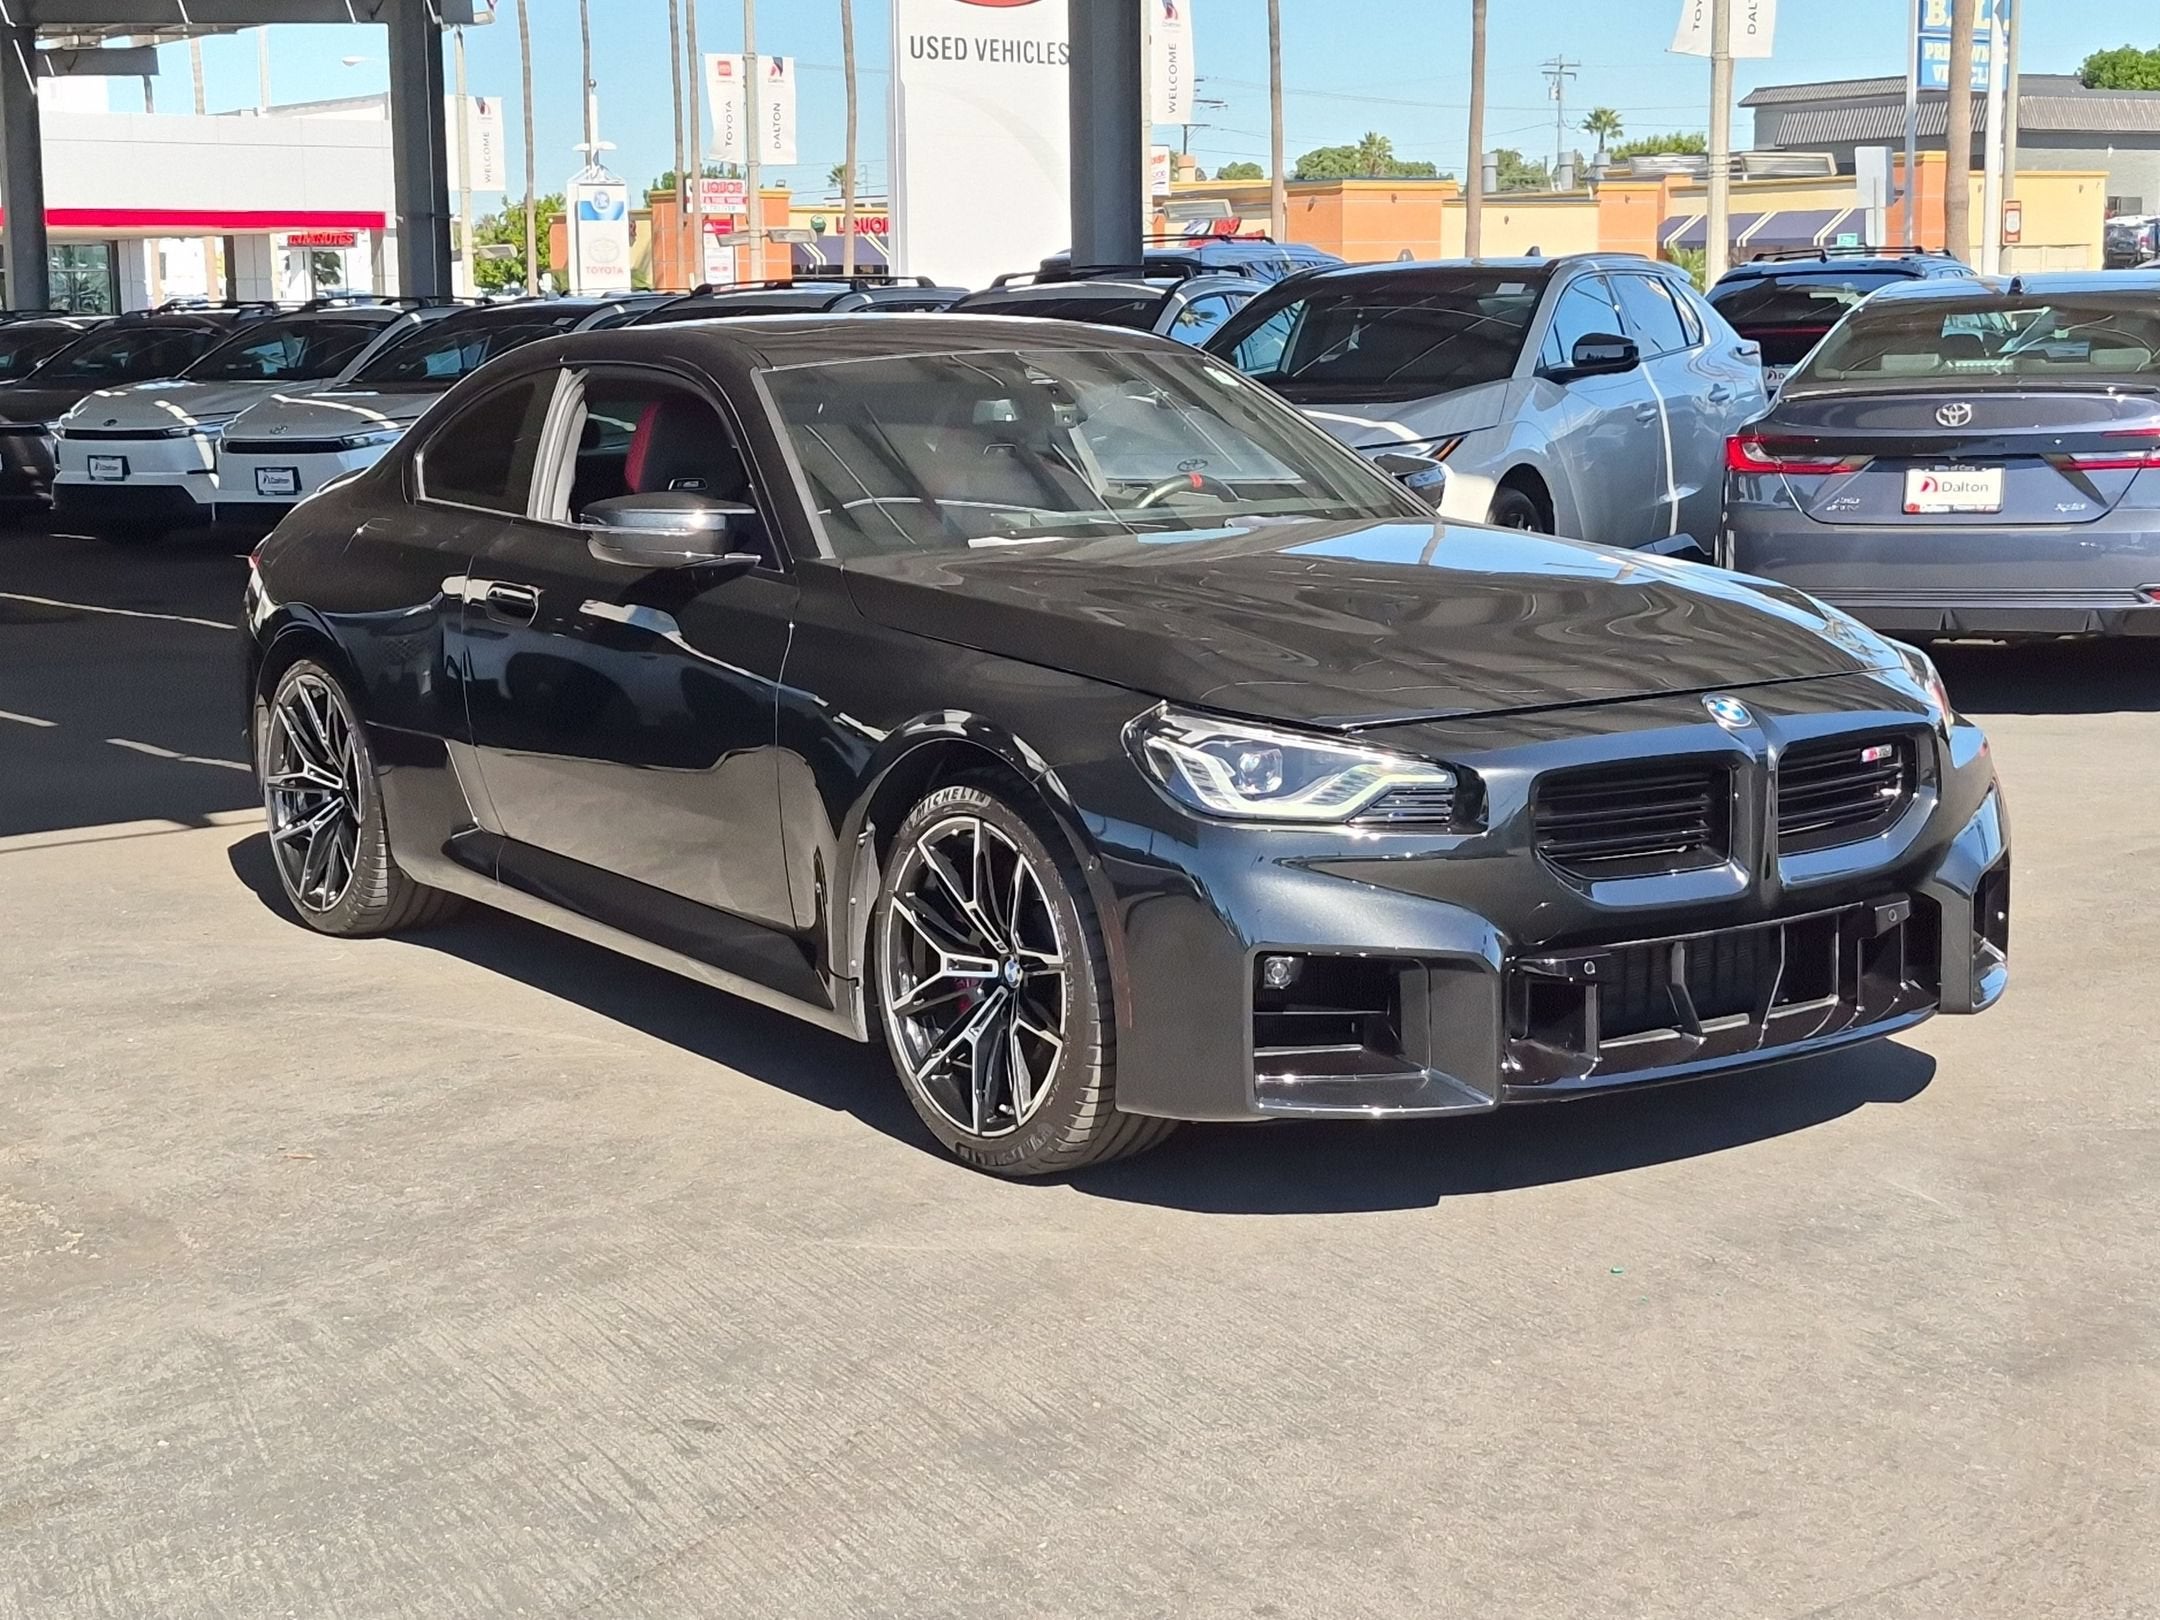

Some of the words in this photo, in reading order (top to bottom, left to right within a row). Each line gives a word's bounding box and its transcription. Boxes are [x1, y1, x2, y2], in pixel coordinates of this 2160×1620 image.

[910, 35, 967, 60] USED
[975, 38, 1069, 65] VEHICLES
[1168, 43, 1178, 114] WELCOME
[773, 103, 782, 149] DALTON
[483, 131, 491, 183] WELCOME
[586, 266, 623, 275] TOYOTA
[1942, 481, 1989, 492] Dalton
[916, 787, 987, 820] MICHELIN
